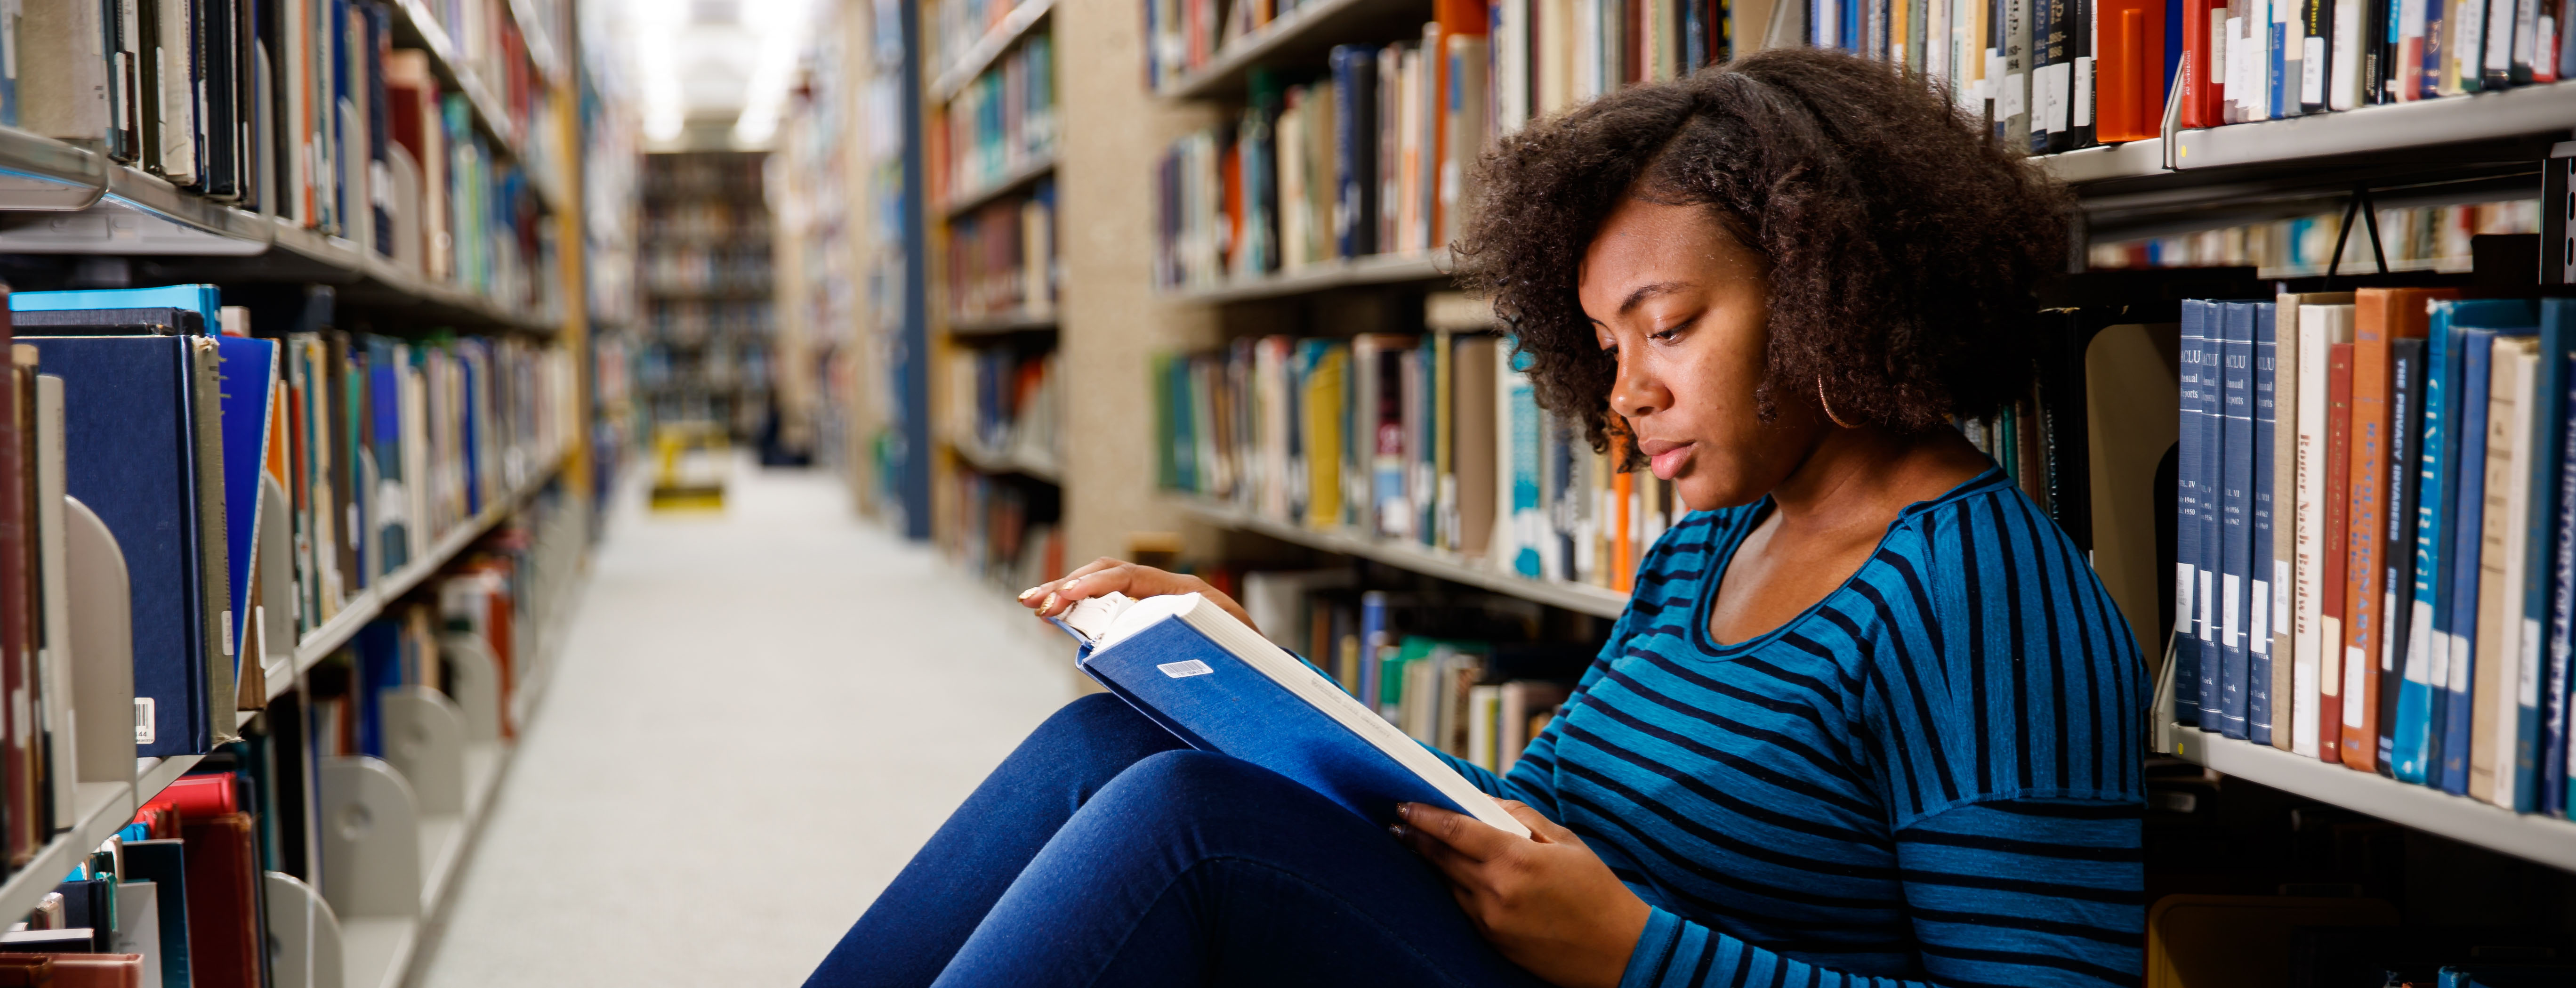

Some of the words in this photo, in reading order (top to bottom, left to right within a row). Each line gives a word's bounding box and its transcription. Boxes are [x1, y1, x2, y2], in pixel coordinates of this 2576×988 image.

[2186, 86, 2190, 95] OF
[2181, 350, 2201, 364] ACLU
[2203, 354, 2218, 367] ACLU
[2226, 355, 2246, 369] ACLU
[2258, 357, 2275, 371] CLU
[2396, 359, 2407, 389] THE
[2258, 396, 2273, 408] ports
[2394, 392, 2405, 461] PRIVACY
[2299, 434, 2310, 494] Roger
[2390, 464, 2401, 541] INVADERS
[2299, 501, 2310, 545] Nash
[2355, 422, 2376, 648] REVOLUTIONARY
[2298, 553, 2309, 634] Baldwin
